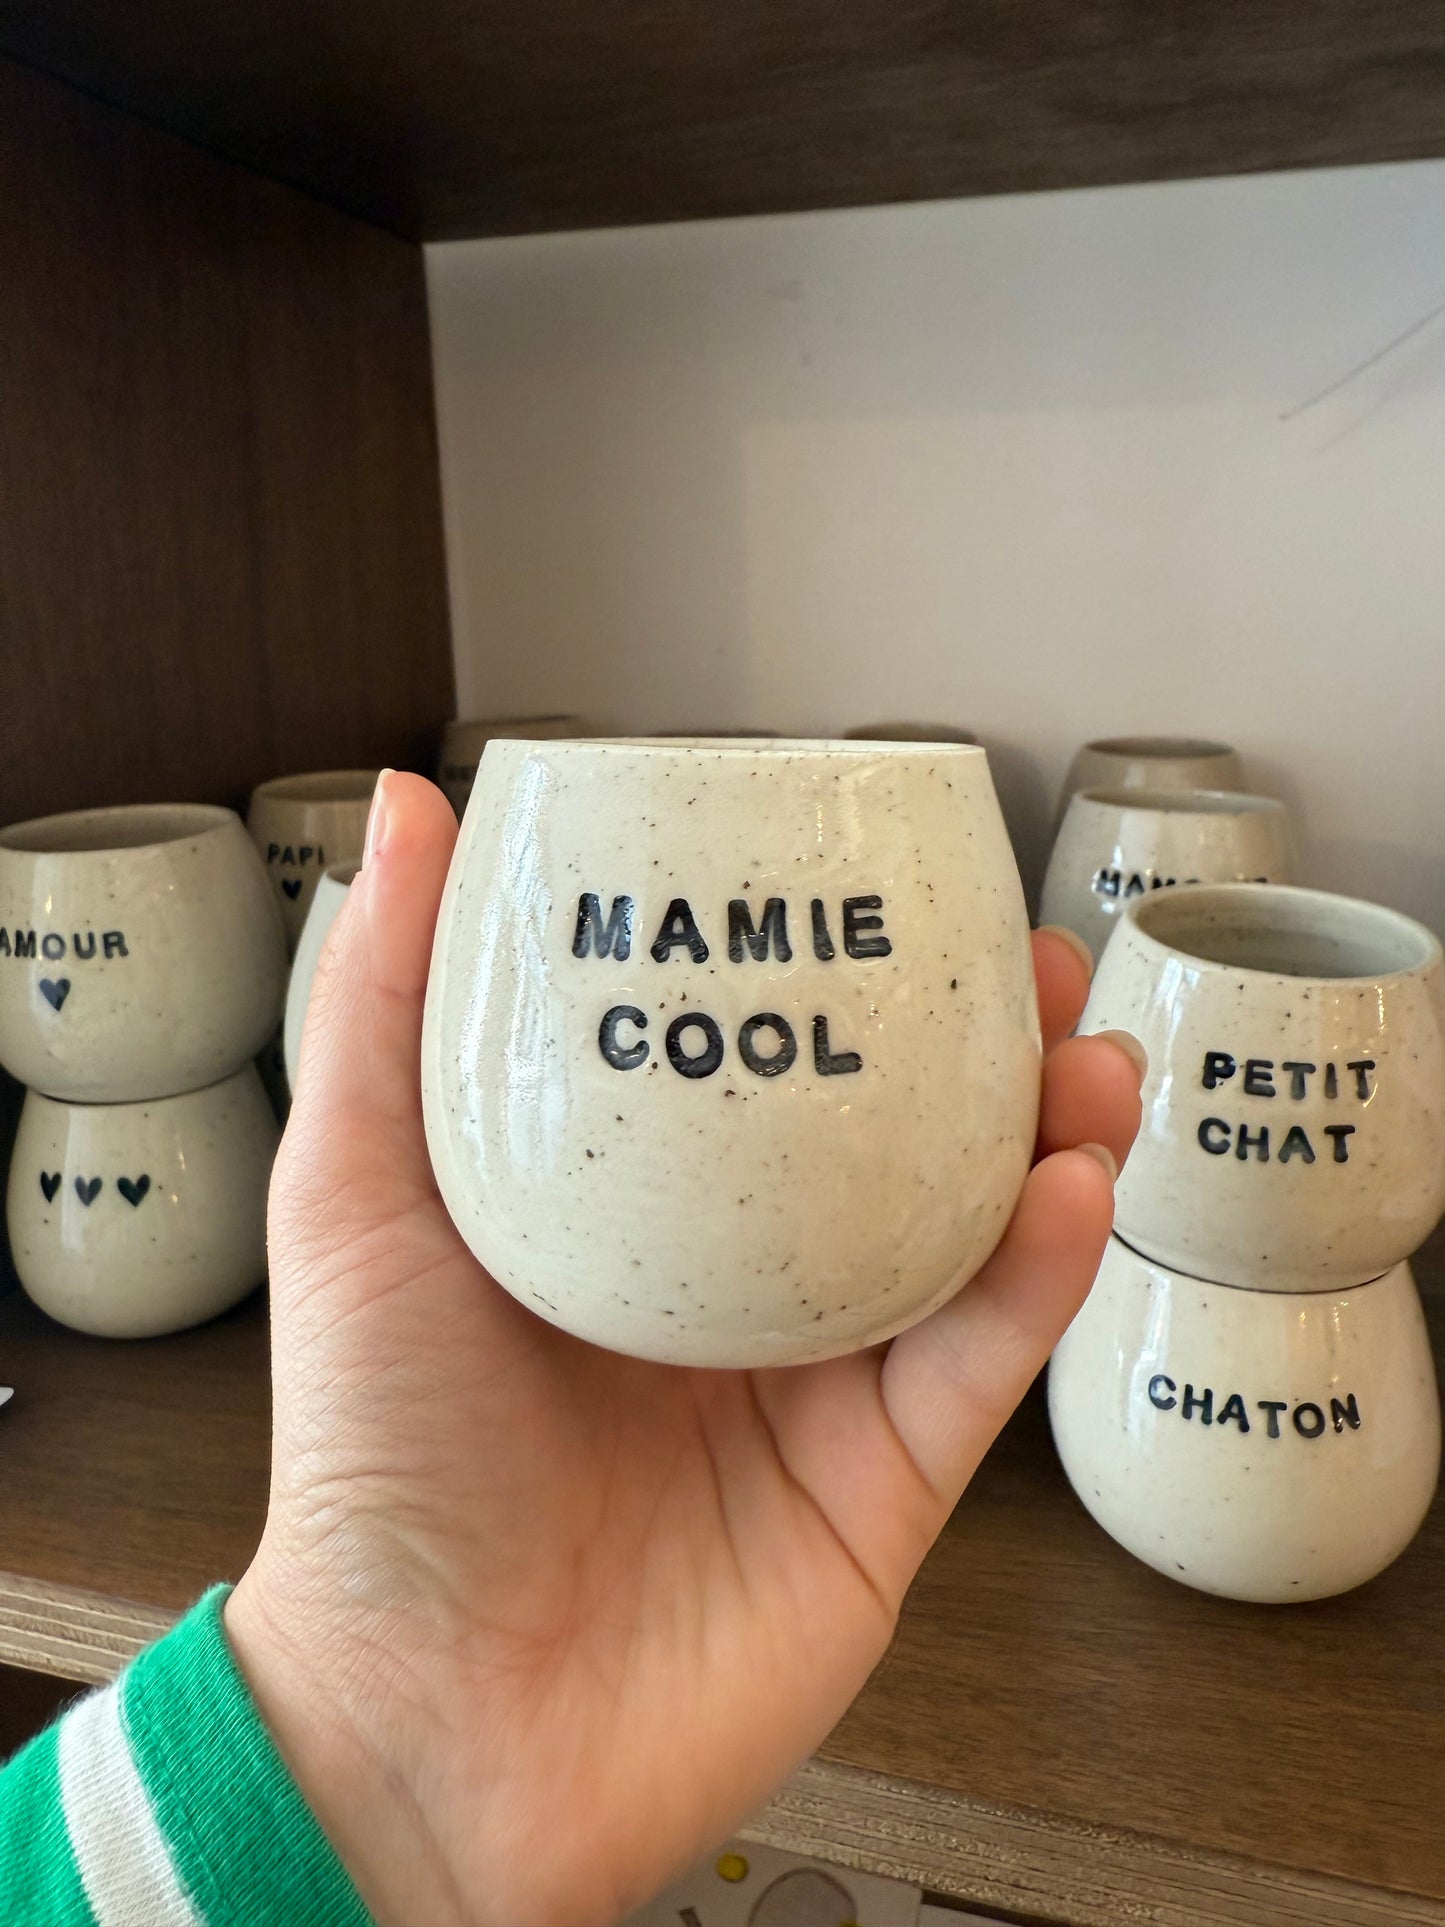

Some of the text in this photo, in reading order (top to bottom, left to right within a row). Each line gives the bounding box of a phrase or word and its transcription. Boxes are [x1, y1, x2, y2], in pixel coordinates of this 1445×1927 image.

[267, 843, 326, 865] PAPI
[572, 892, 892, 963] MAMIE
[599, 1004, 863, 1079] COOL
[1202, 1051, 1376, 1100] PETIT
[1198, 1117, 1356, 1164] CHAT
[1148, 1374, 1361, 1439] CHATON
